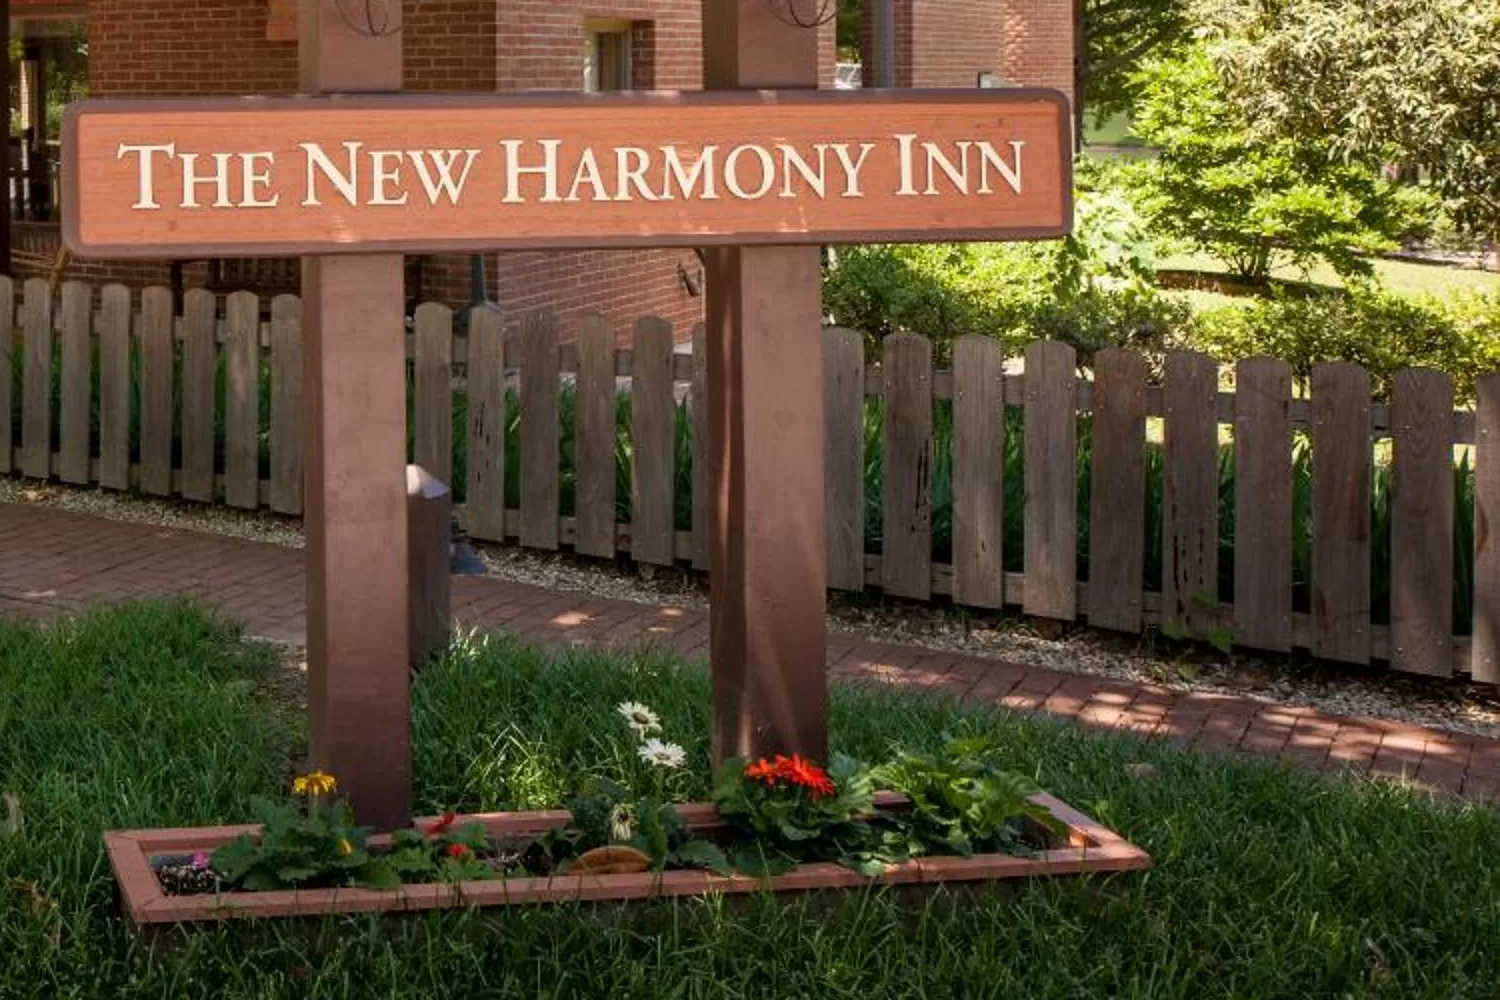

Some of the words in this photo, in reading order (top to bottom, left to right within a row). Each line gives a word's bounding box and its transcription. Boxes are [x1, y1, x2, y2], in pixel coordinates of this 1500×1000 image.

[116, 142, 279, 210] THE
[299, 140, 481, 208] NEW
[500, 138, 875, 203] HARMONY
[894, 132, 1025, 197] INN
